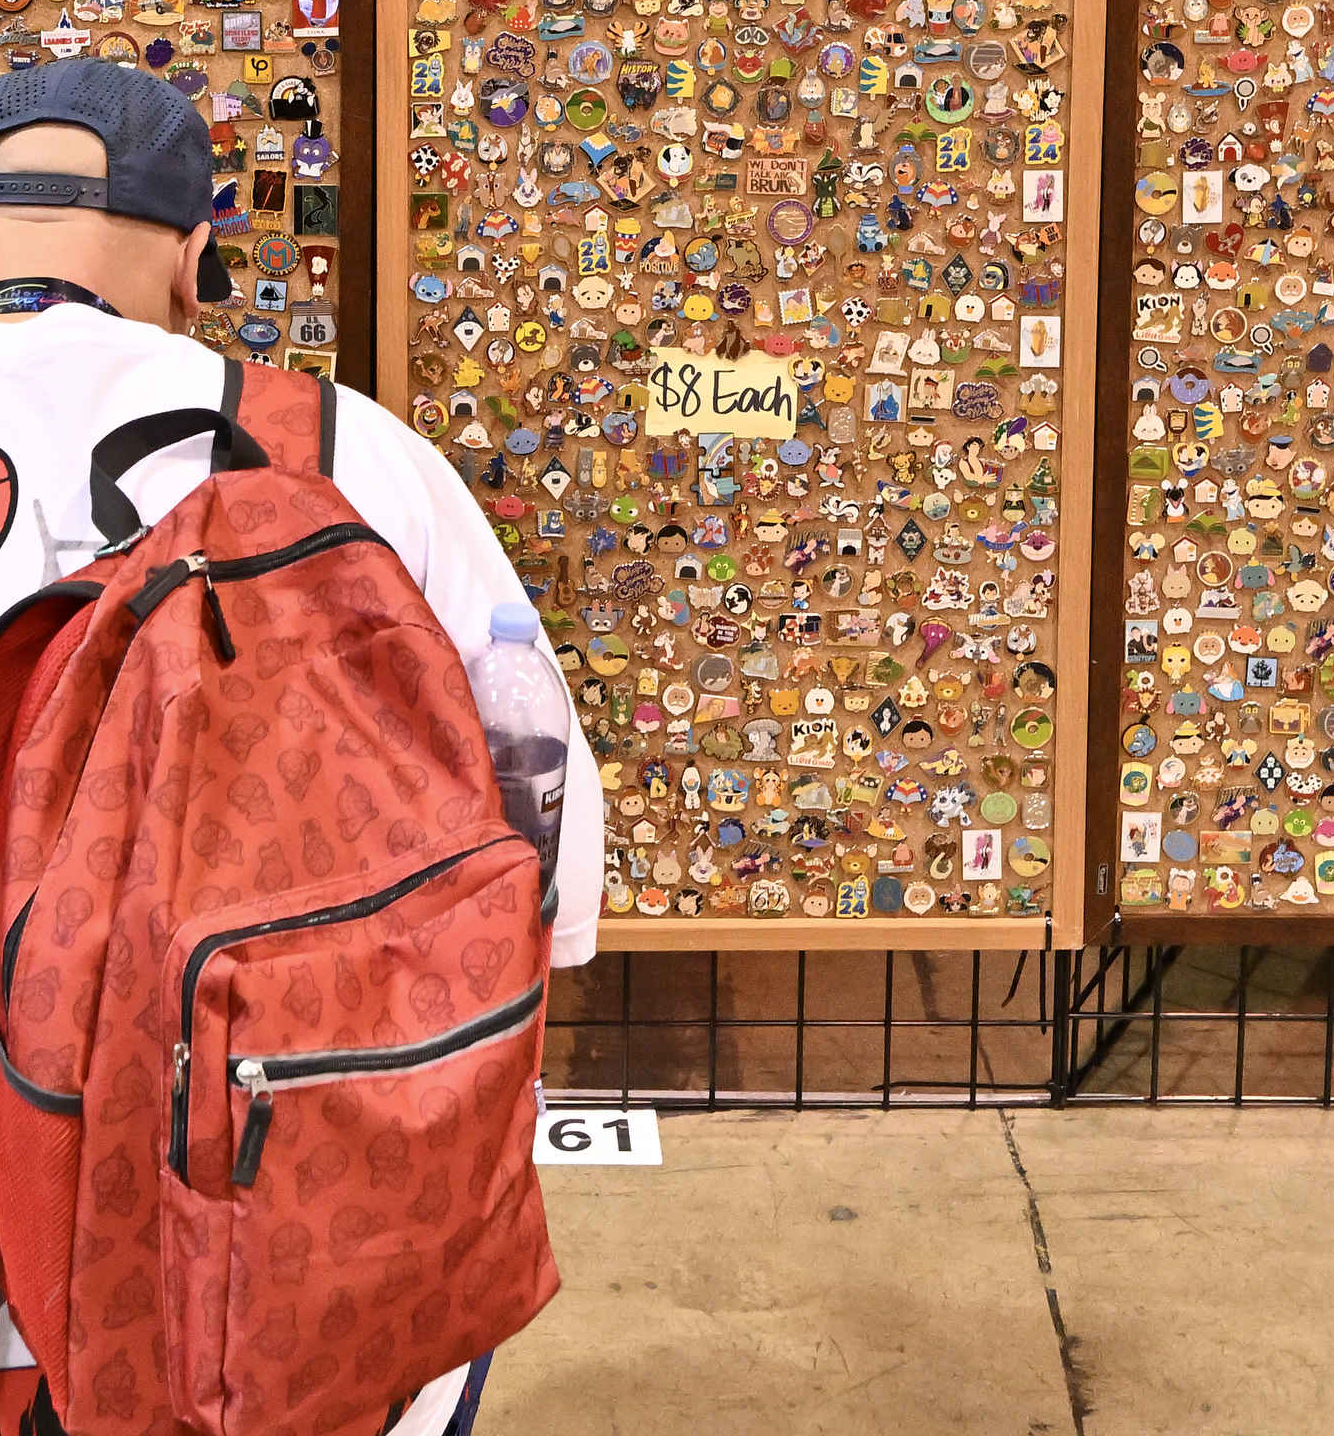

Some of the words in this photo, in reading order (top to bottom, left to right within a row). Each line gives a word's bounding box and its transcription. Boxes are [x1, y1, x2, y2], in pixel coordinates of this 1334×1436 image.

[620, 65, 658, 78] HISTORY
[639, 261, 679, 273] POSITIVE
[1140, 295, 1181, 311] KION
[300, 323, 326, 341] 66
[650, 361, 702, 418] $8
[713, 370, 792, 421] Each
[793, 724, 835, 738] KION
[549, 1119, 632, 1152] 61
